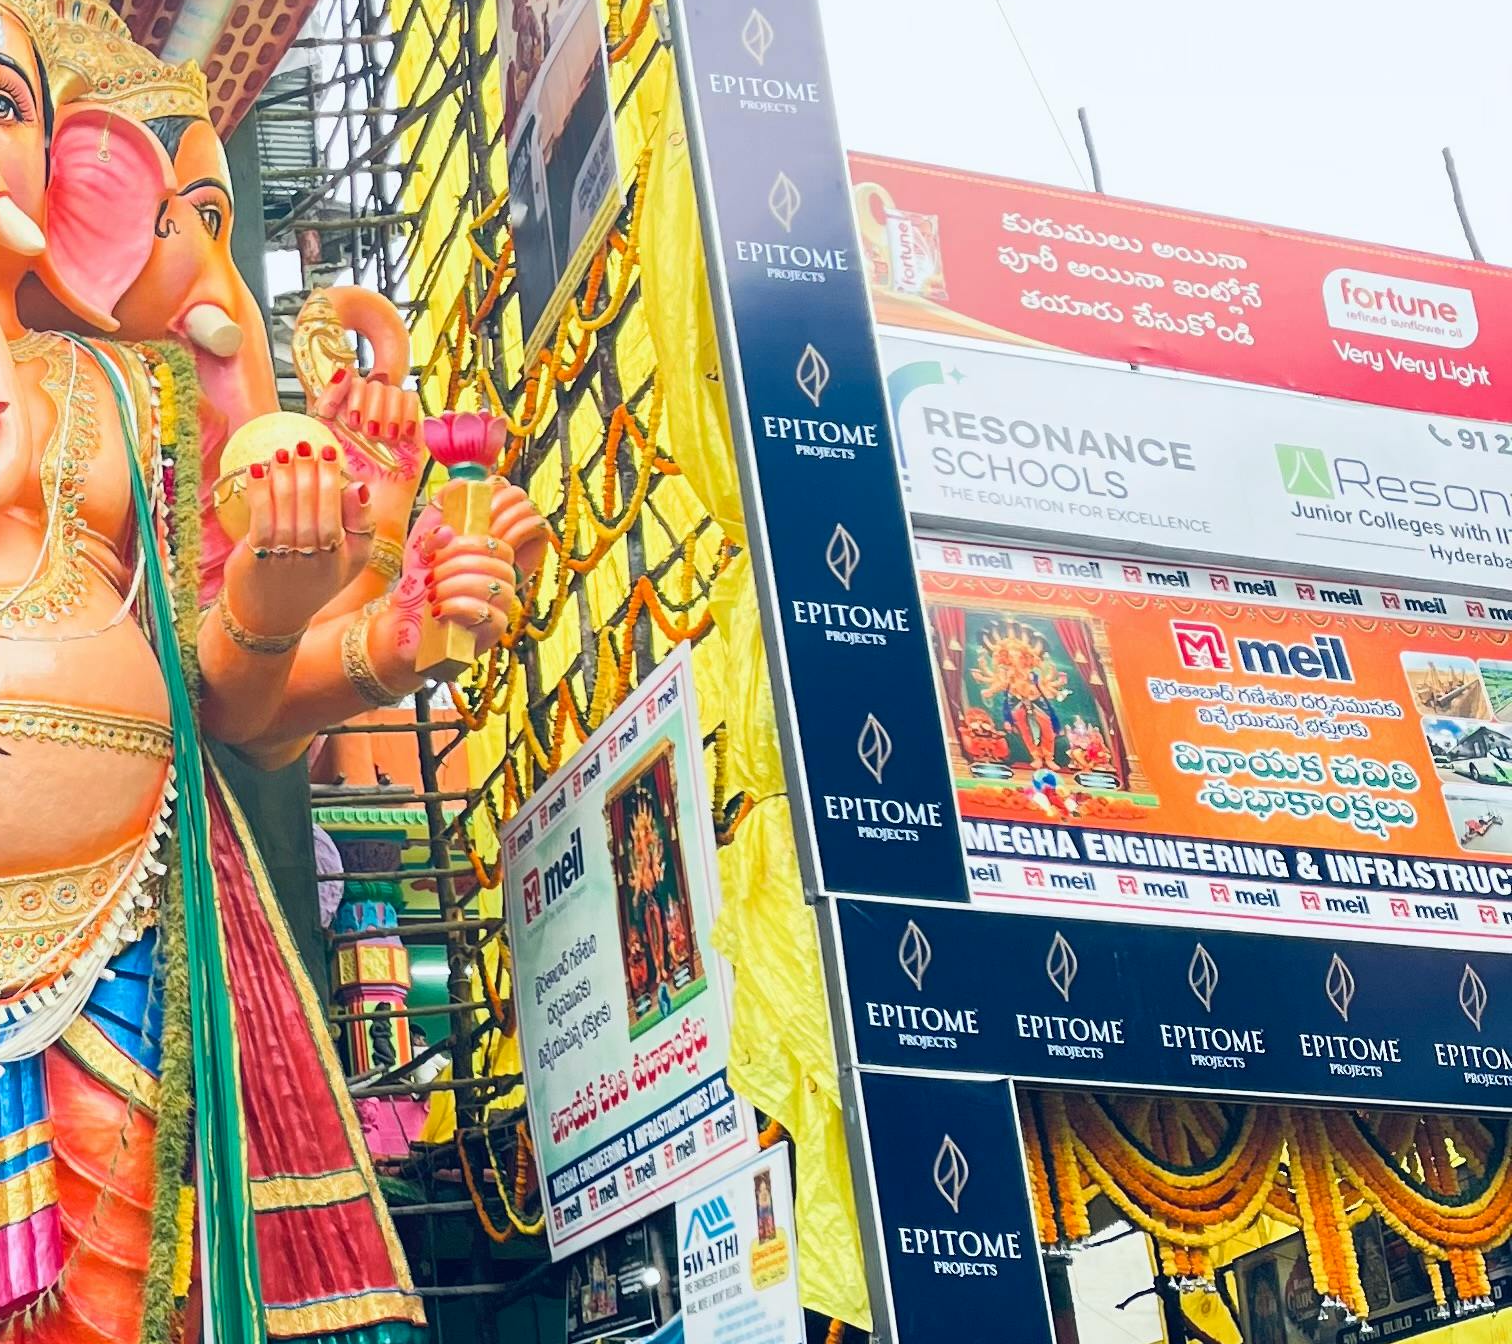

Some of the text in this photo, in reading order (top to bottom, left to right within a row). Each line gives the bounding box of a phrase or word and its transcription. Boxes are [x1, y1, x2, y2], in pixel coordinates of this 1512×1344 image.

[710, 74, 819, 102] EPITOME
[740, 101, 797, 115] PROJECTS
[1341, 278, 1458, 324] fortune
[1347, 311, 1387, 326] refined
[1391, 317, 1445, 336] sunflower
[1333, 339, 1492, 387] Very Very Light
[923, 406, 1196, 472] RESONANCE
[931, 446, 1129, 499] SCHOOLS
[939, 484, 1212, 535] THE EQUATION FOR EXCELLENCE
[1291, 501, 1353, 524] Junior
[1359, 509, 1444, 537] Colleges
[1450, 521, 1489, 543] with
[968, 552, 1447, 614] meil meil meil
[1238, 637, 1352, 681] meil
[582, 676, 678, 787] meil meil meil
[1175, 744, 1418, 791] వినాయక చవితి
[824, 796, 942, 826] EPITOME
[859, 826, 919, 843] PROJECTS
[960, 821, 1080, 859] MEGHA
[1083, 832, 1289, 878] ENGINEERING
[1296, 852, 1322, 880] &
[544, 827, 584, 905] meil
[1235, 888, 1459, 921] meil meil
[866, 1002, 978, 1033] EPITOME
[1160, 1025, 1265, 1053] EPITOME
[899, 1035, 958, 1051] PROJECTS
[1191, 1055, 1246, 1071] PROJECTS
[684, 1234, 738, 1278] SWATHI
